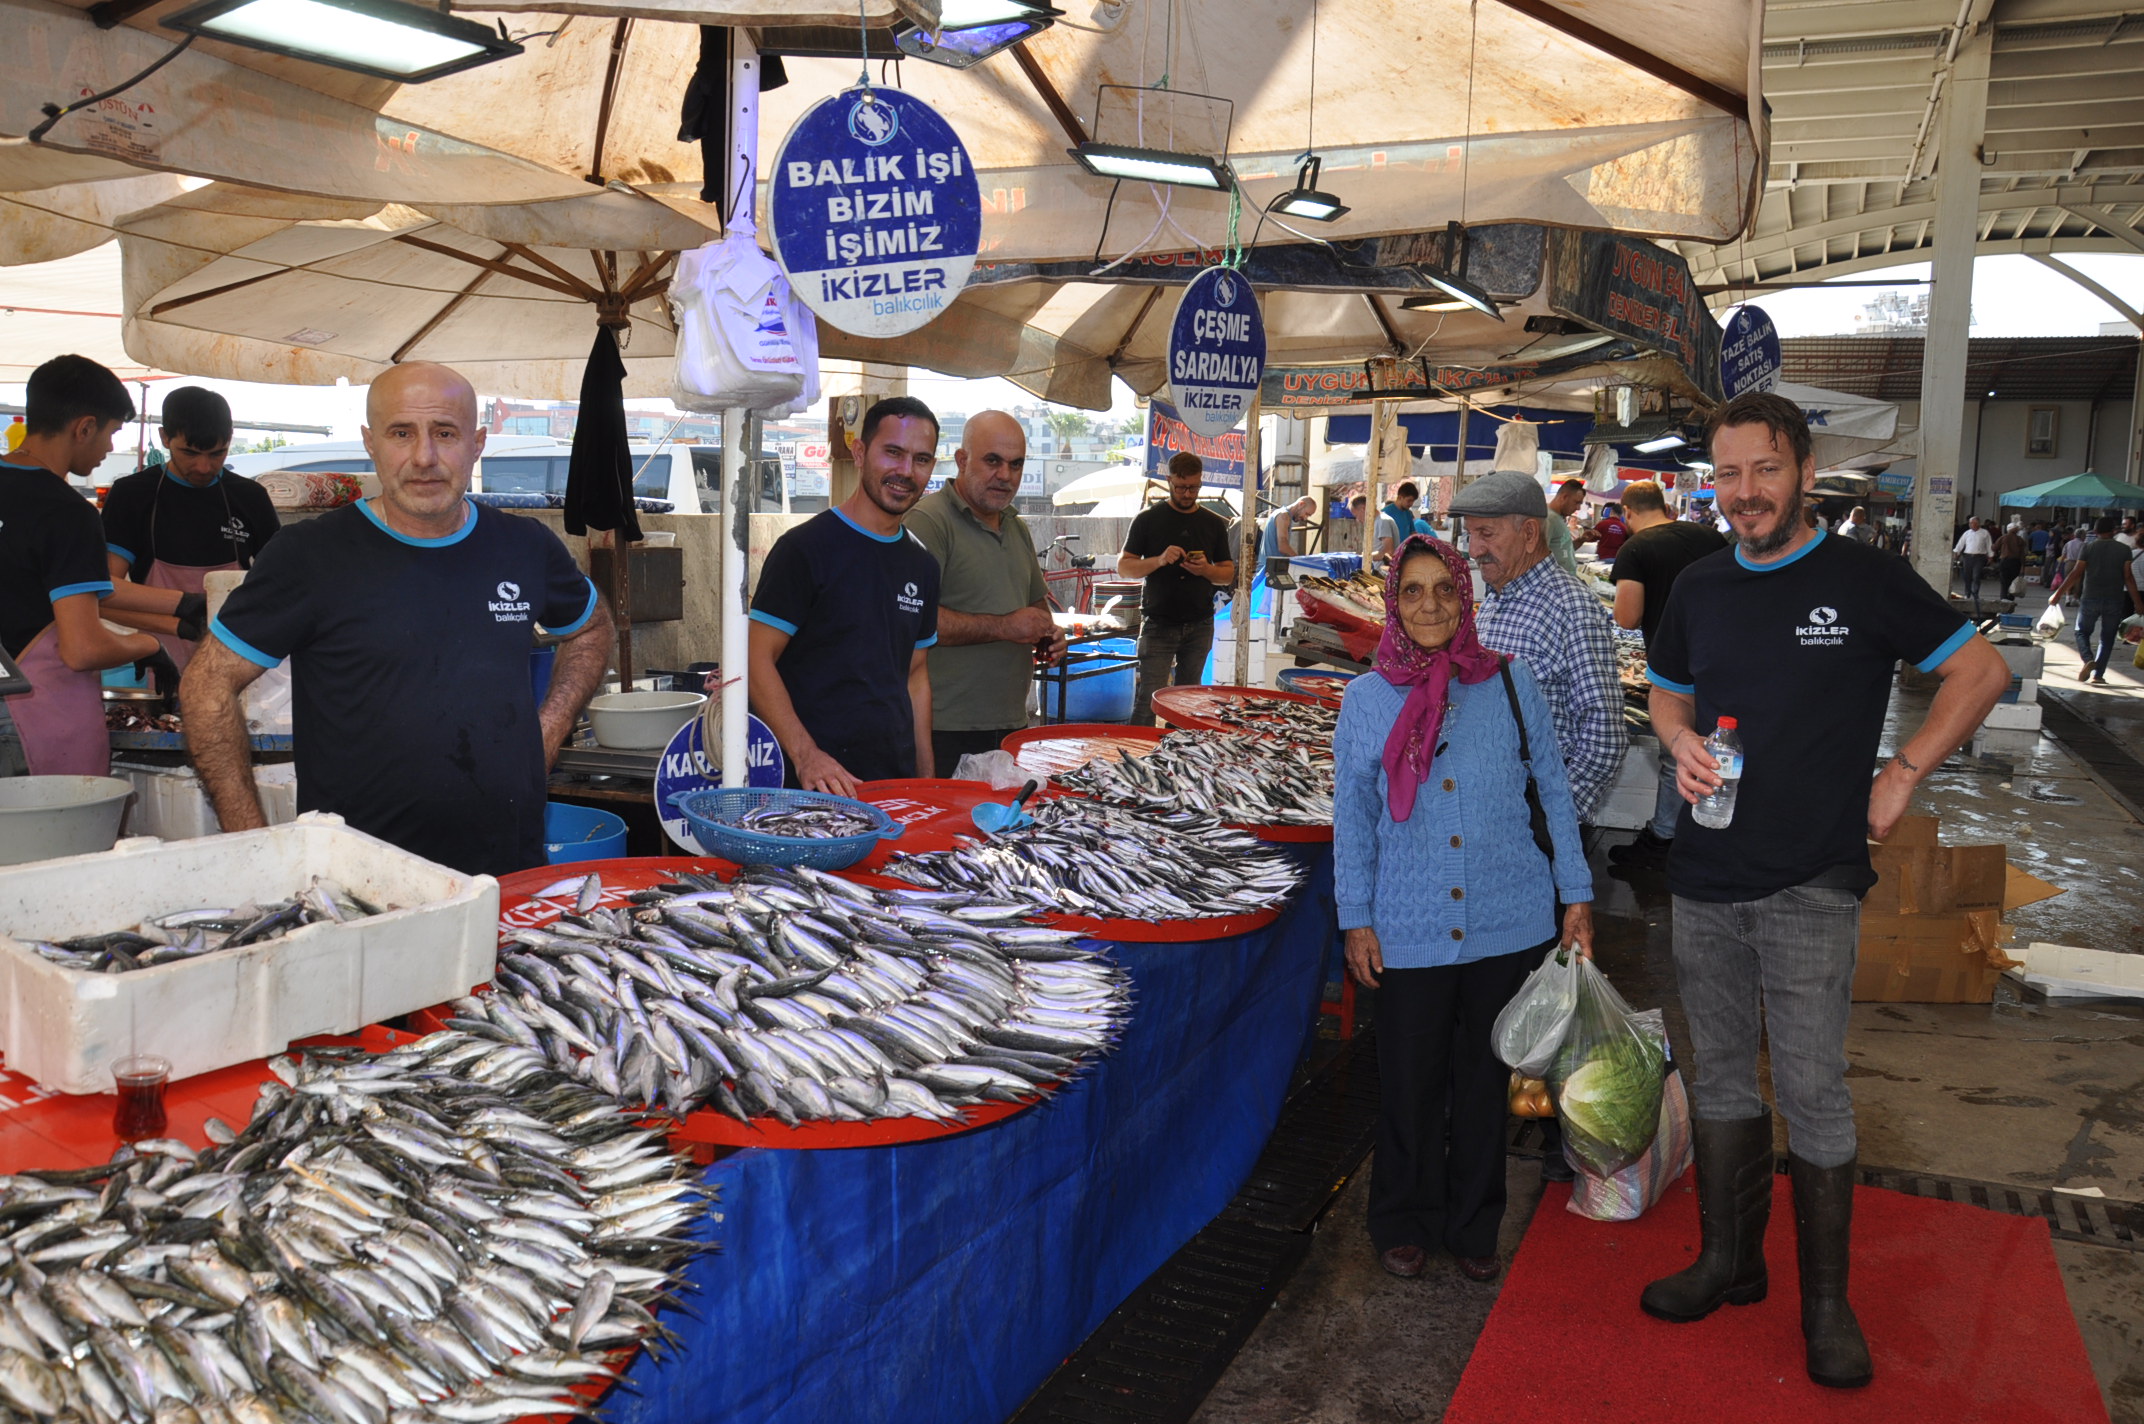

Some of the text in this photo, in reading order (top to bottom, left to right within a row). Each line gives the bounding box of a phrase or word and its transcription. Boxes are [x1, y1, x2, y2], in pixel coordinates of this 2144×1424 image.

[787, 146, 963, 188] BALIK İŞİ
[827, 186, 934, 223] BİZİM
[825, 222, 944, 265] İŞİMİZ
[821, 267, 948, 302] İKİZLER
[873, 292, 944, 316] balıkçılık
[1193, 309, 1251, 346] ÇEŞME
[1721, 338, 1746, 362] TAZE
[1746, 320, 1774, 346] BALIK
[1174, 350, 1258, 383] SARDALYA
[1733, 358, 1774, 394] NOKTASI
[1737, 346, 1764, 372] SATIŞ
[1184, 388, 1242, 410] İKİZLER
[488, 600, 531, 611] İKİZLER
[1795, 625, 1850, 636] İKİZLER
[1800, 636, 1844, 646] balıkçılık
